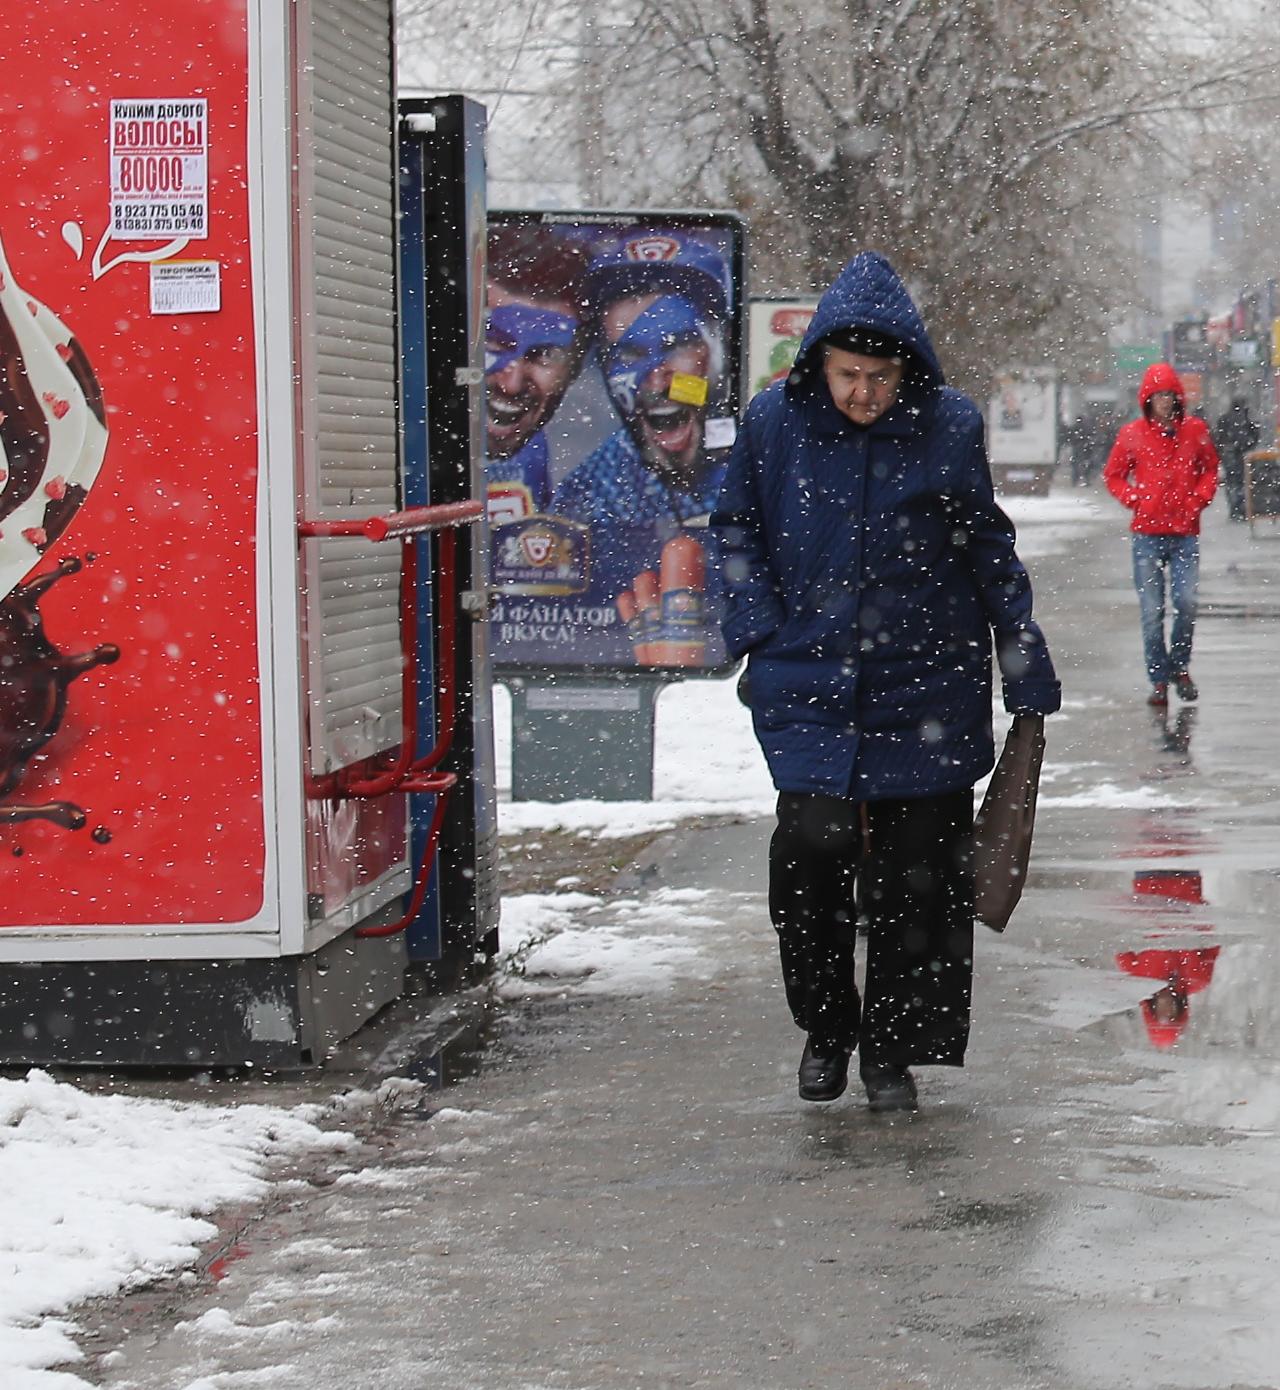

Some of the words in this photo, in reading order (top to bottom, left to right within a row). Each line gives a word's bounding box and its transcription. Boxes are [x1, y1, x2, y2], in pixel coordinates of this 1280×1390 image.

[114, 104, 155, 118] КУПИМ
[157, 104, 204, 119] ДОРОГО
[114, 121, 203, 147] ВОЛОСЫ
[114, 205, 122, 217] 8
[125, 205, 147, 217] 923
[150, 205, 169, 217] 775
[171, 205, 186, 217] 05
[189, 205, 203, 217] 40
[114, 219, 121, 230] 8
[154, 219, 172, 230] 375
[190, 219, 203, 230] 40
[160, 266, 211, 275] ПРОПИСКА
[509, 604, 616, 625] ФАНАТОВ
